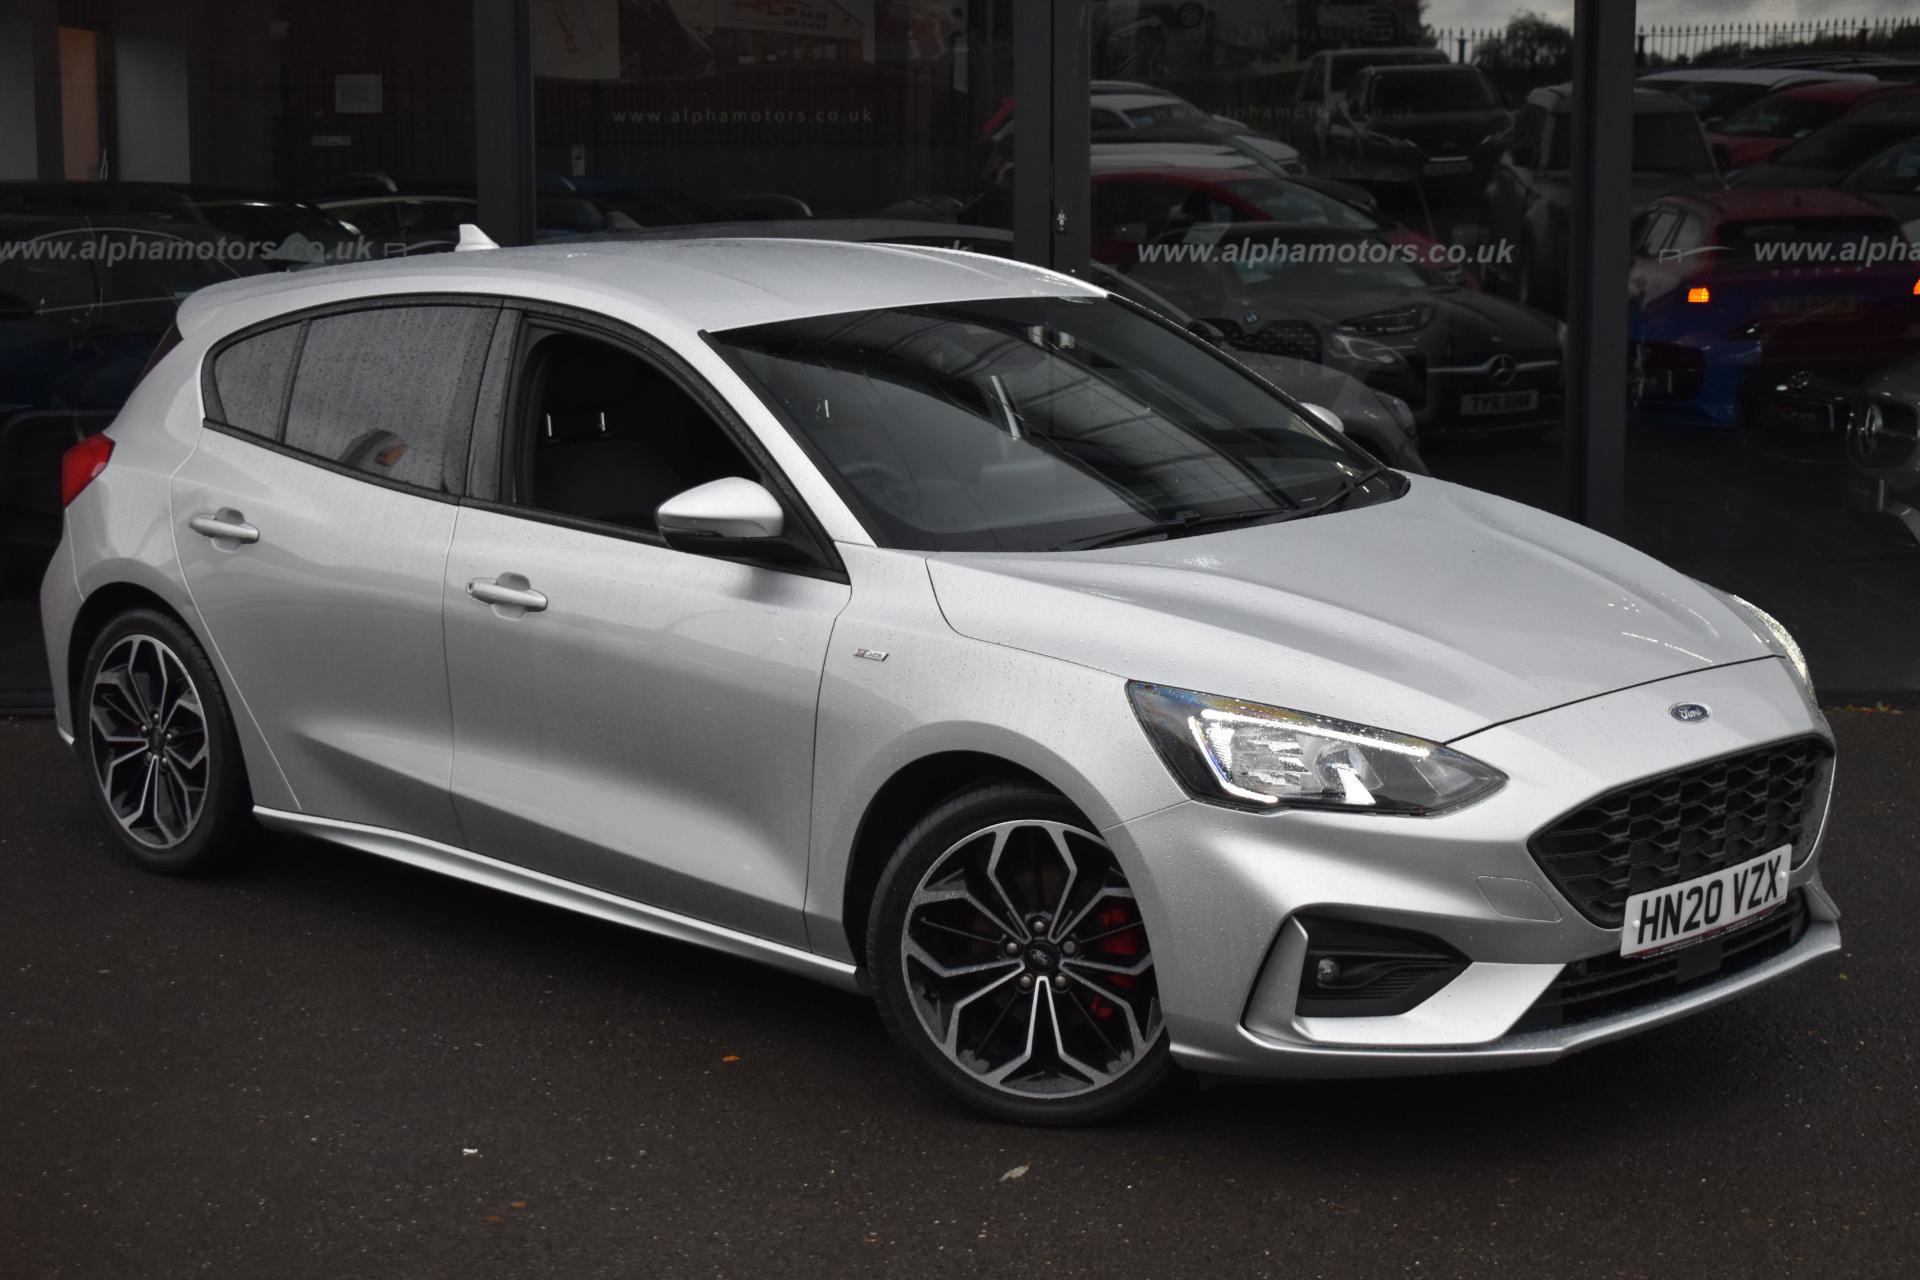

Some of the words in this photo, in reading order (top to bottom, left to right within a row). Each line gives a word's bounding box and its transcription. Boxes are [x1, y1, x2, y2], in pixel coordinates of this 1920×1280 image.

[611, 107, 873, 126] www.alphamotors.co.uk
[0, 235, 373, 268] www.alphamotors.co.uk
[1137, 237, 1515, 269] www.alphamotors.co.uk
[1637, 879, 1724, 945] HN20
[1733, 855, 1781, 915] VZX
